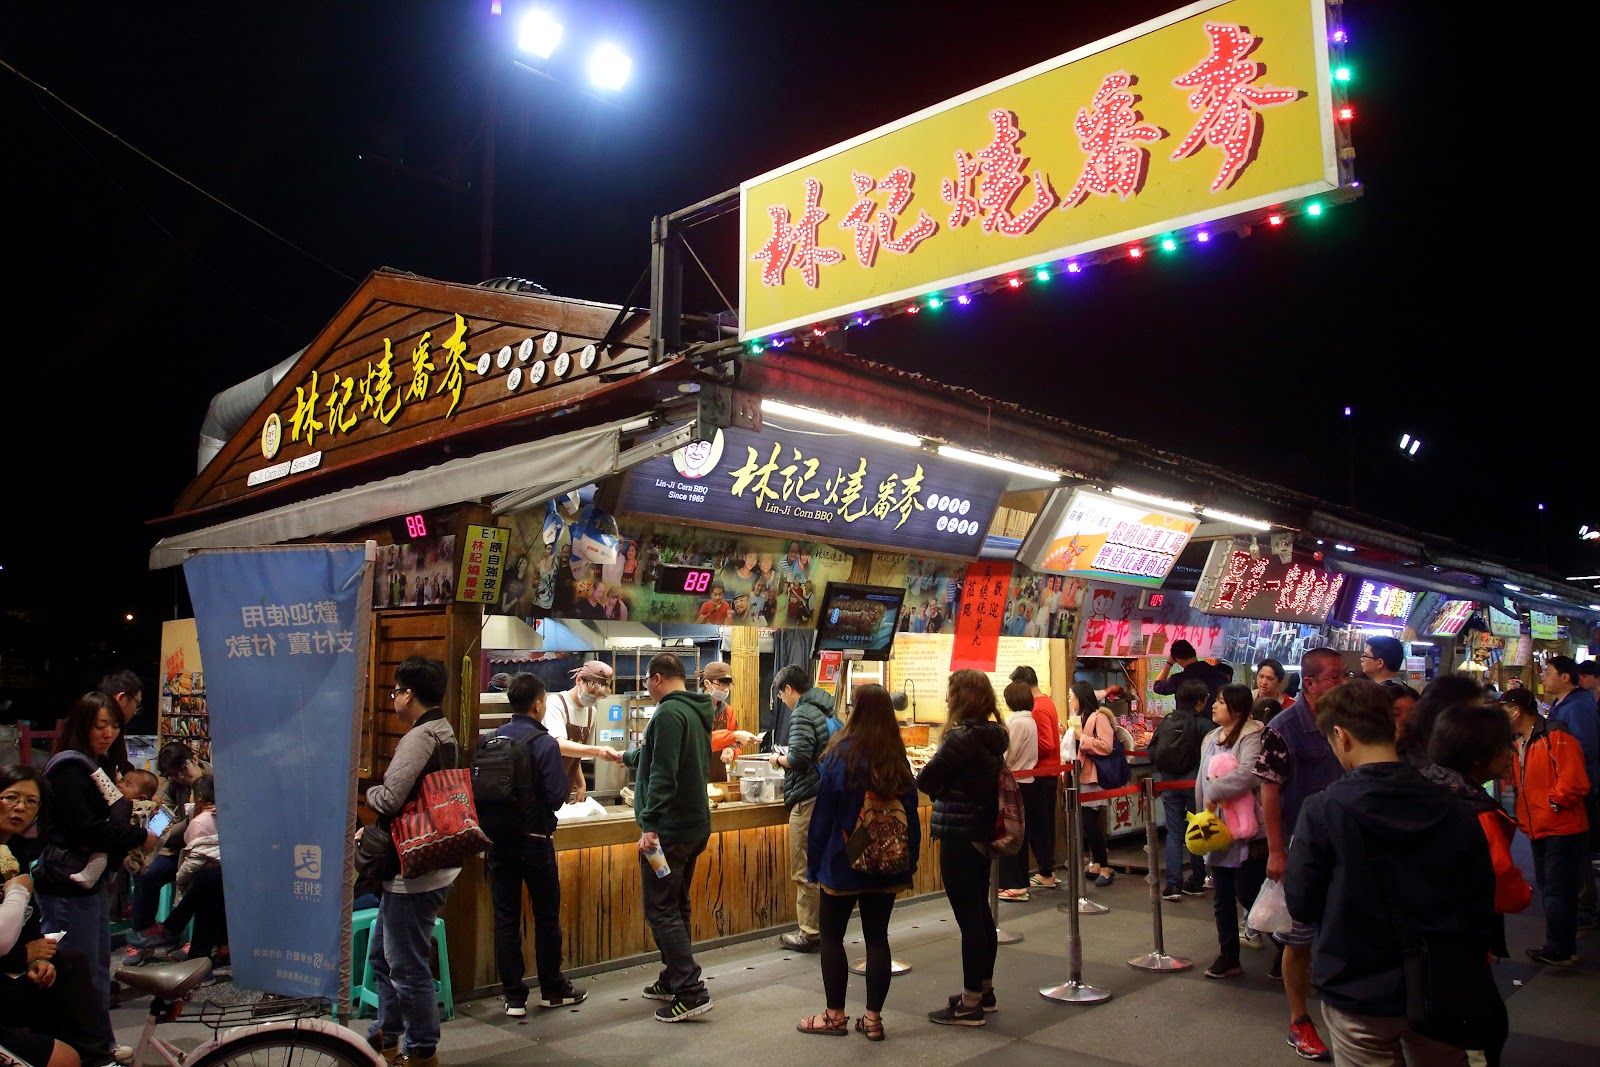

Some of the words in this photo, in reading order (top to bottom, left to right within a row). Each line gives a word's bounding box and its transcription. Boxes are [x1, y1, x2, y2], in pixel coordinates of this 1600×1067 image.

[294, 461, 307, 471] Since
[655, 479, 675, 489] Lin-Ji
[677, 482, 692, 492] Corn
[693, 485, 709, 495] BBQ
[668, 491, 687, 500] Since
[689, 494, 704, 503] 1965
[765, 502, 791, 515] Lin-Ji
[794, 507, 813, 518] Corn
[814, 510, 833, 523] BBQ
[405, 514, 427, 538] 88
[481, 528, 497, 539] E1
[463, 539, 485, 600] 林記燒番麥
[481, 541, 502, 602] 原自強夜市
[684, 571, 711, 592] 88
[971, 565, 992, 646] 馬總統英九
[988, 580, 1003, 618] 歡迎
[1150, 594, 1164, 607] 109
